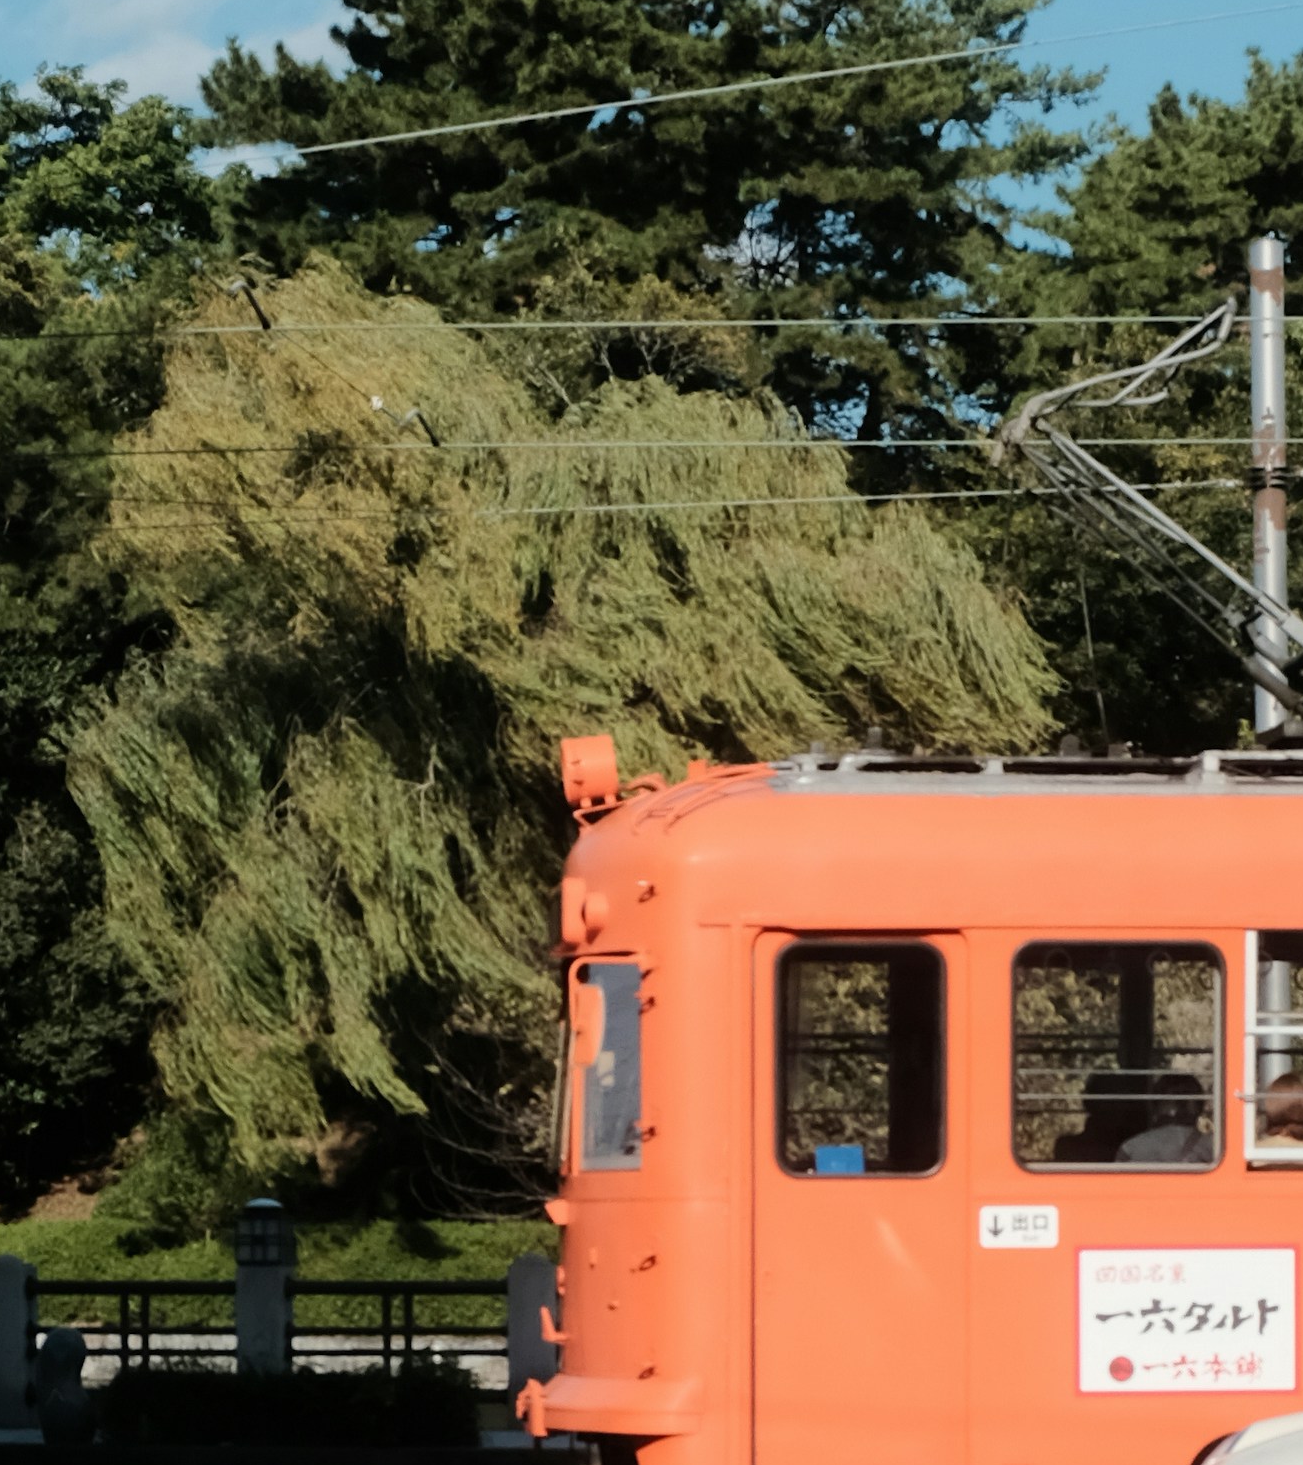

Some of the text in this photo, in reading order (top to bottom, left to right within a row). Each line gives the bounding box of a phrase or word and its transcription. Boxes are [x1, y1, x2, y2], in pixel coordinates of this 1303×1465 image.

[1012, 1214, 1048, 1230] 出口
[1095, 1298, 1279, 1335] 一六タルト
